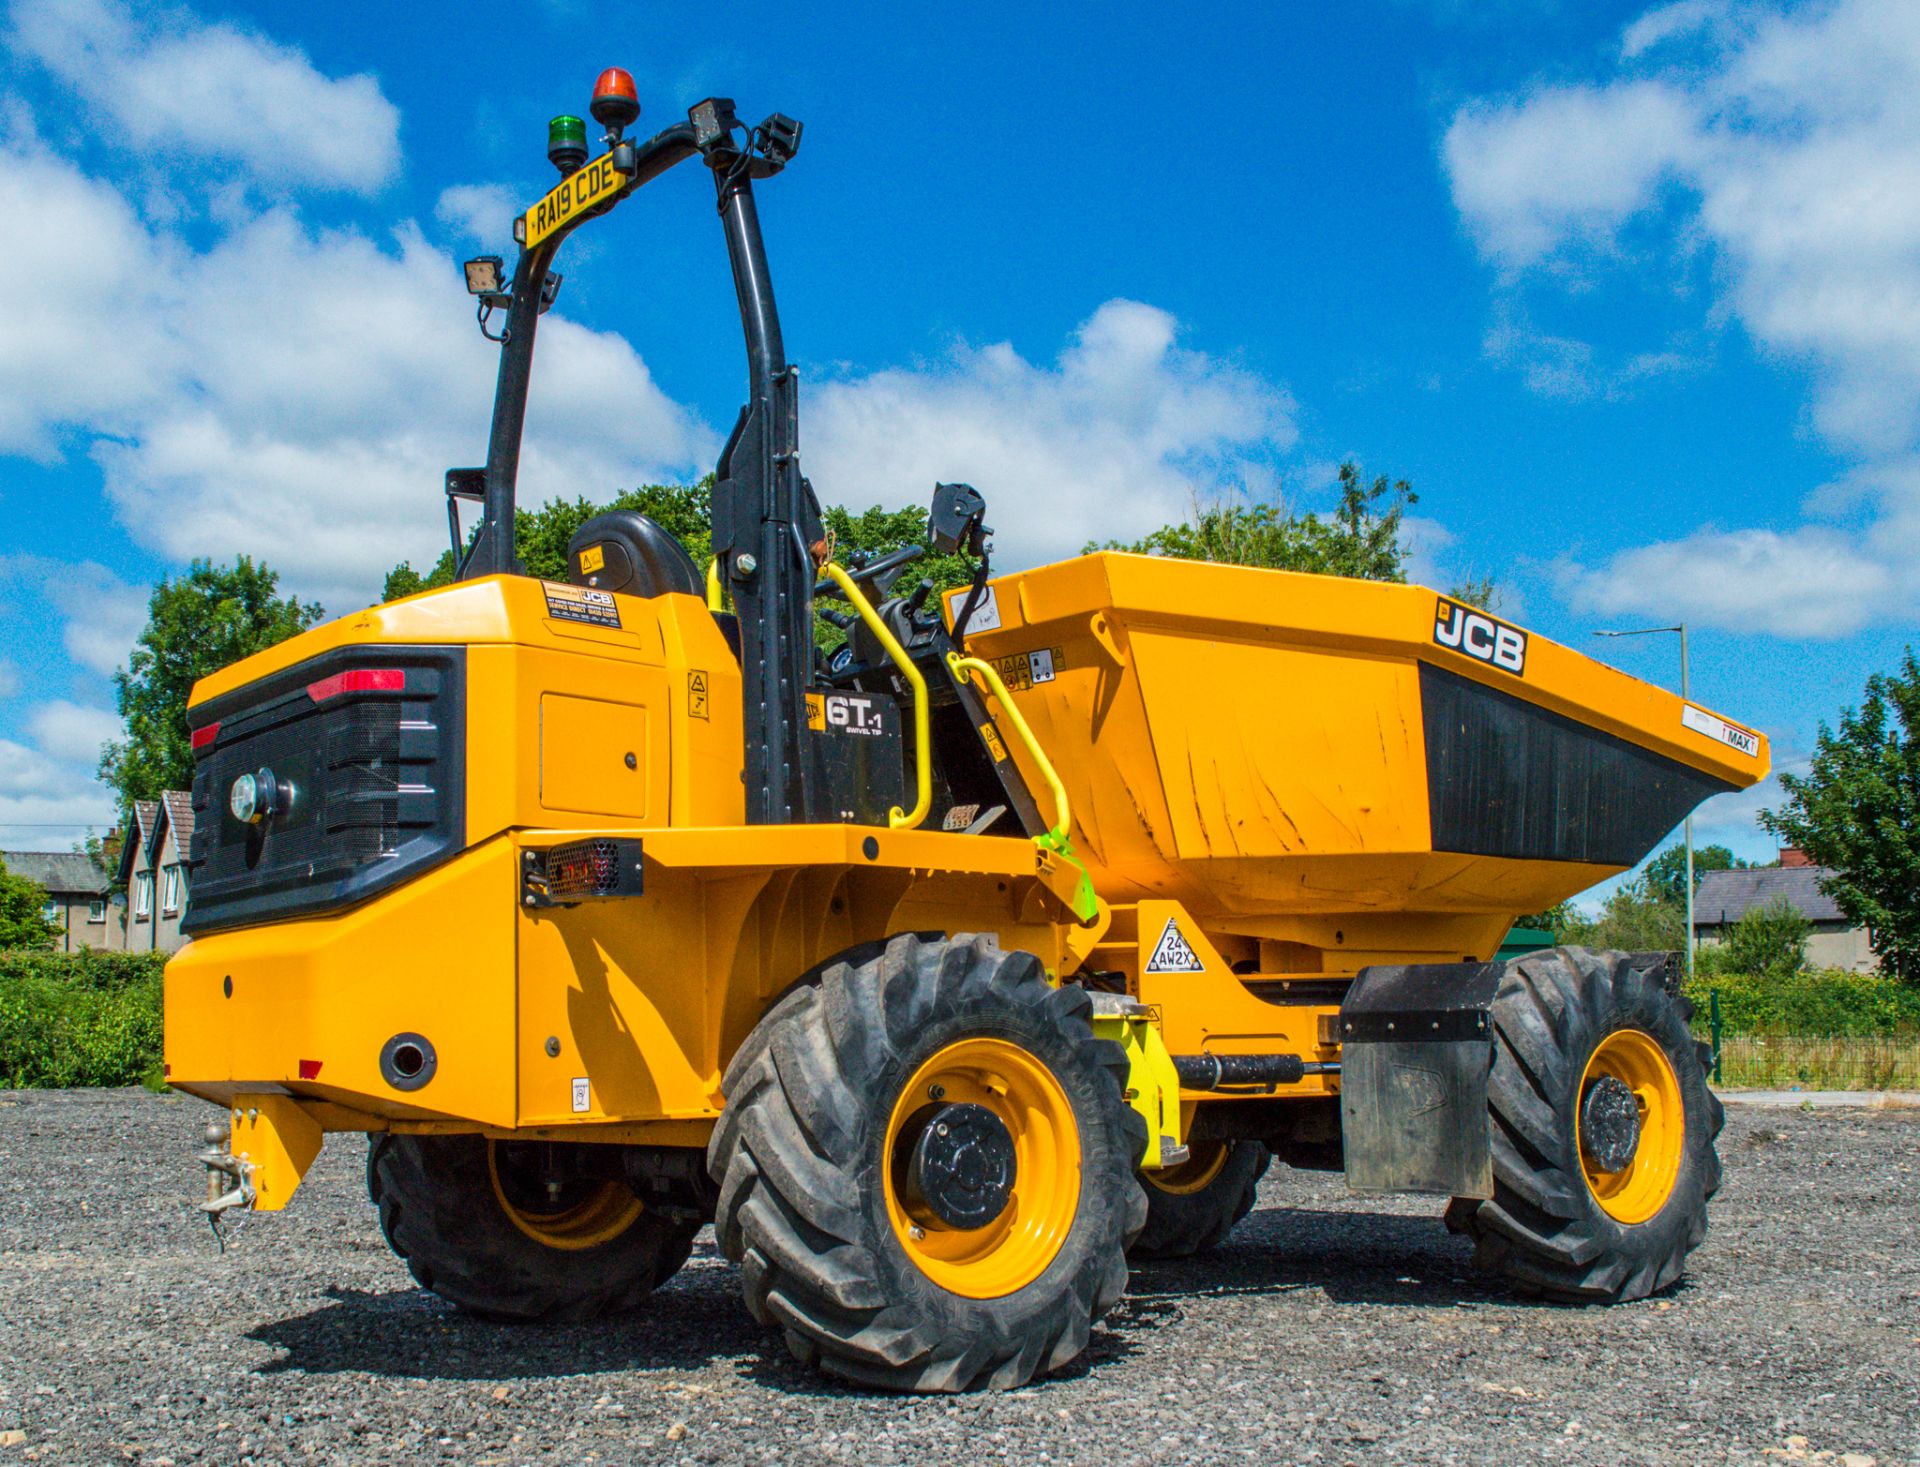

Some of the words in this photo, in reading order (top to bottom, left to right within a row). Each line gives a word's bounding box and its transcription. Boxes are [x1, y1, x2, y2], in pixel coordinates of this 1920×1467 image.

[537, 183, 571, 235] RA19
[576, 159, 613, 205] CDE
[583, 591, 612, 605] JCB
[1436, 608, 1524, 672] JCB
[846, 727, 871, 735] SWIVEL
[1728, 730, 1750, 752] MAX
[1167, 937, 1182, 950] 24
[1159, 951, 1191, 966] AW2X
